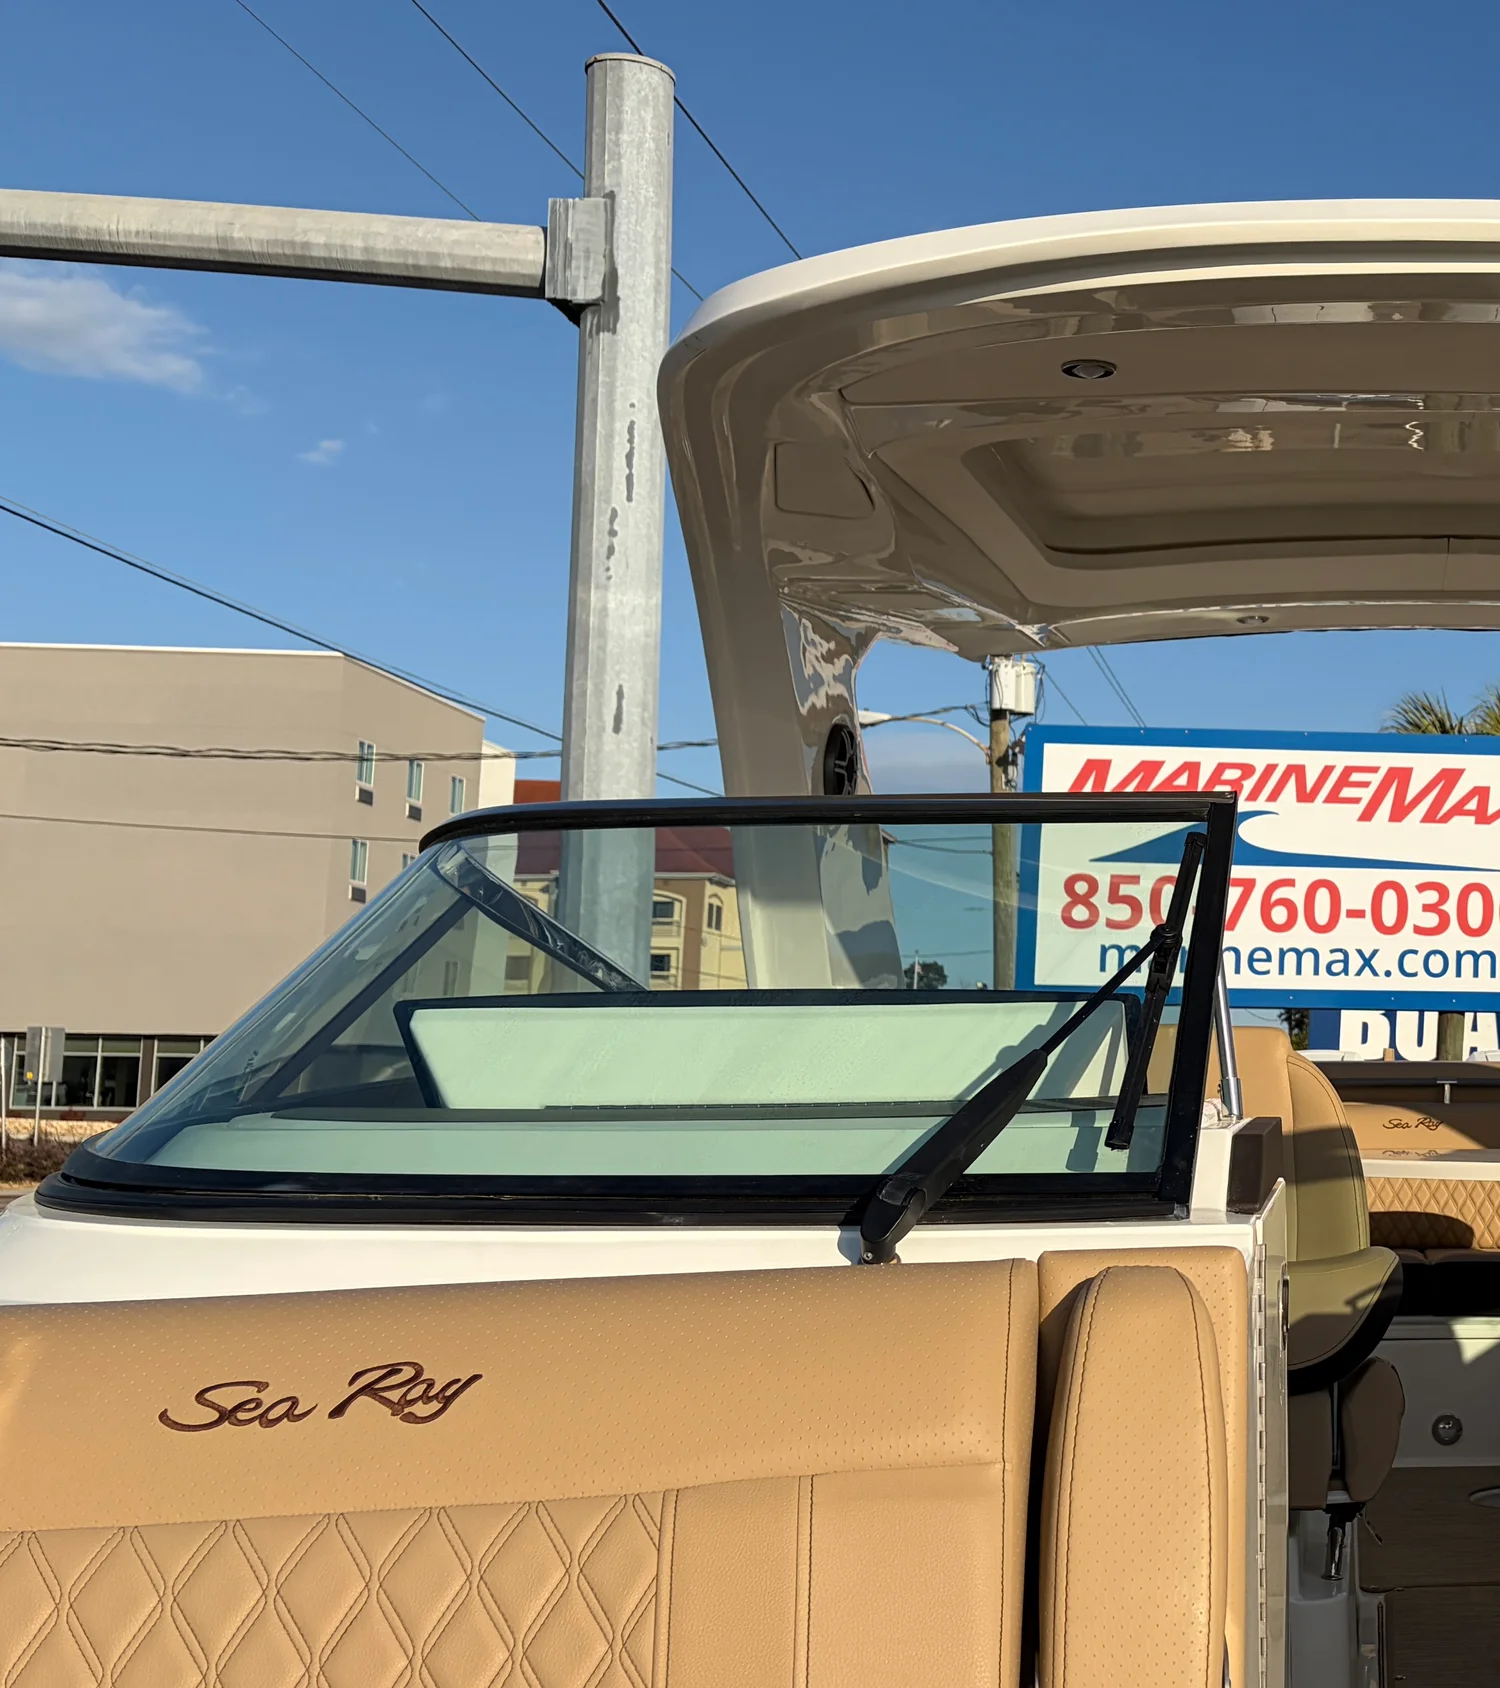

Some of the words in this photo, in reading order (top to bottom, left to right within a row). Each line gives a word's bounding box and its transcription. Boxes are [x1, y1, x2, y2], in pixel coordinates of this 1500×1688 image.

[1382, 1118, 1413, 1130] Sea
[1414, 1116, 1444, 1131] Ray
[157, 1380, 318, 1432] Sea
[327, 1361, 483, 1425] Ray
